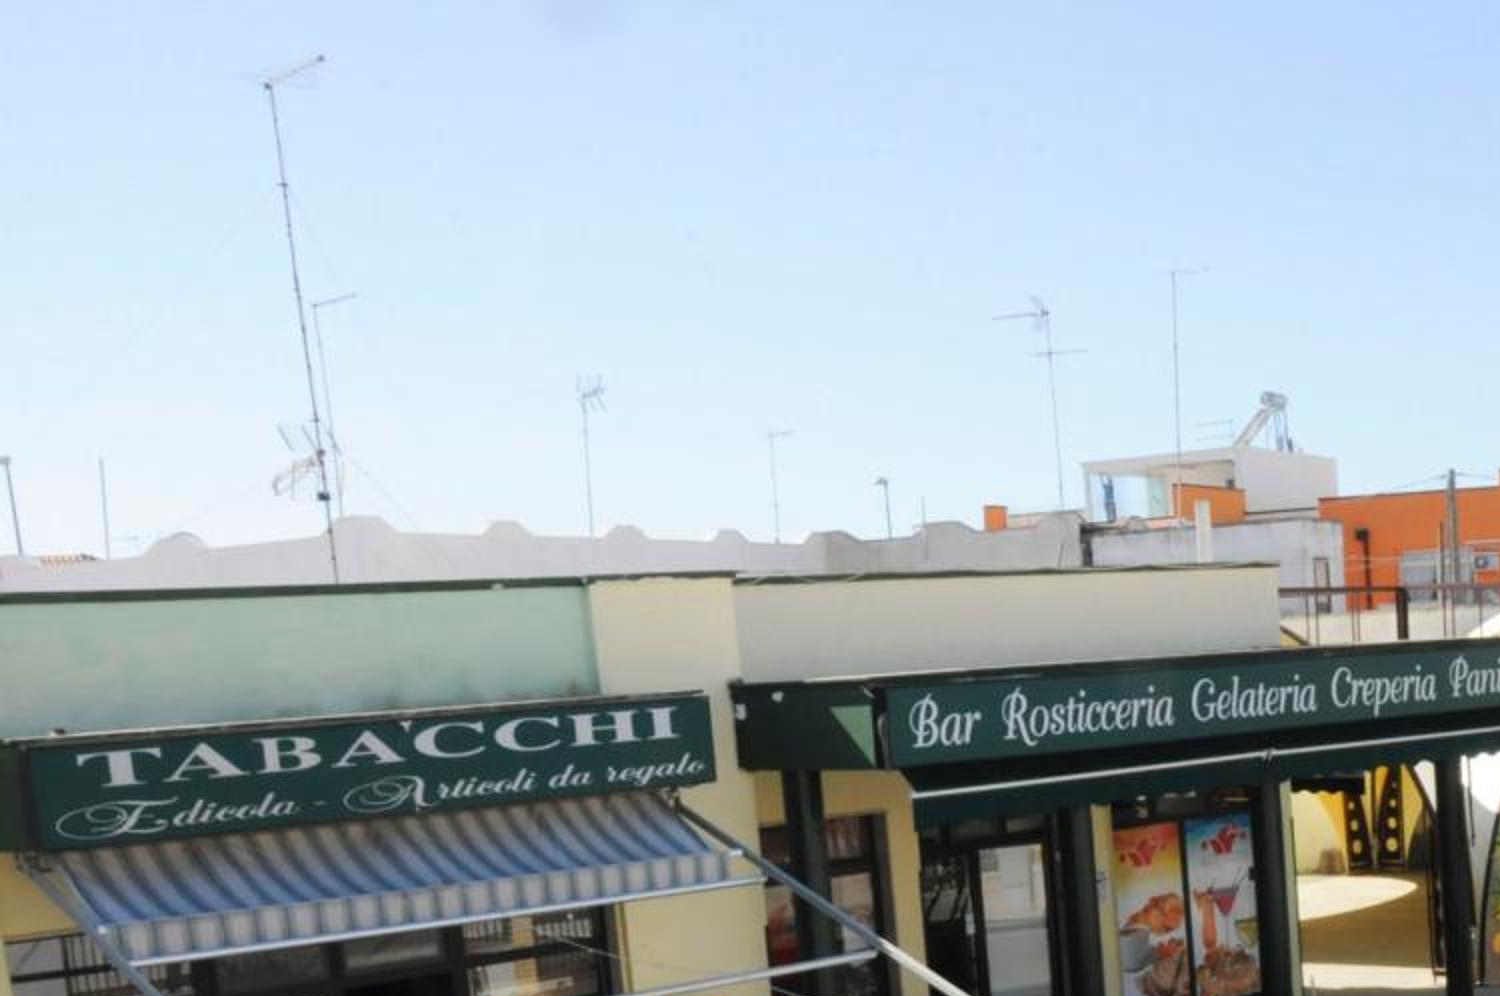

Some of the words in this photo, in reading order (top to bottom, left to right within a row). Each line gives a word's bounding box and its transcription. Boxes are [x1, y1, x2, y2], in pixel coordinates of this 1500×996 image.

[76, 706, 681, 787] TABACCHI
[909, 693, 981, 749] Bar
[1001, 685, 1173, 745] Rosticceria
[1191, 672, 1318, 724] Gelateria
[1330, 664, 1436, 717] Creperia
[55, 791, 298, 840] Edicola
[342, 773, 537, 814] Articoli
[549, 765, 592, 788] da
[605, 752, 706, 789] regalo
